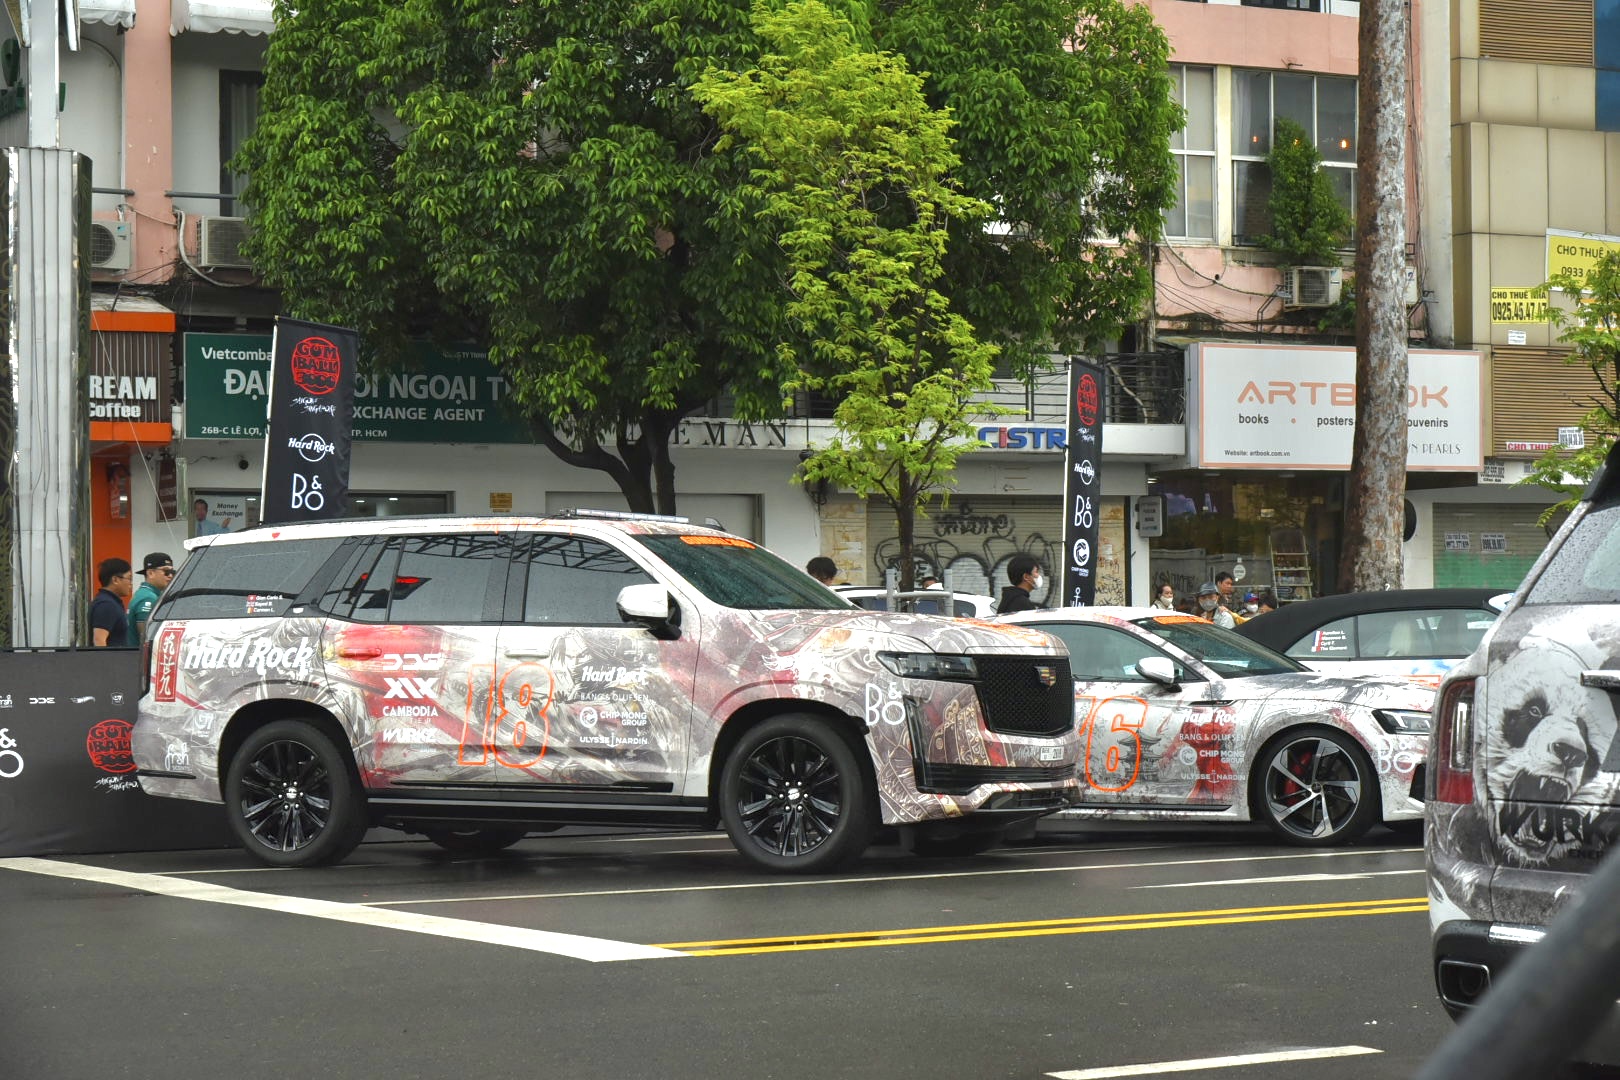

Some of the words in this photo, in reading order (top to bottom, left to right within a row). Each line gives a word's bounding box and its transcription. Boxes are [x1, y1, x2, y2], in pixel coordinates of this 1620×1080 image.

[1557, 245, 1577, 256] CHO
[1580, 247, 1603, 258] THUÊ
[1561, 266, 1584, 278] 0933
[1492, 291, 1507, 299] CHO
[389, 373, 476, 405] NGOẠI
[1237, 380, 1449, 409] ARTBK
[433, 408, 486, 422] AGENT
[1238, 413, 1270, 425] books
[1316, 416, 1354, 427] posters
[201, 426, 229, 435] 26B-C
[288, 437, 314, 450] Hard
[313, 440, 335, 455] Rock
[1422, 443, 1461, 455] PEARLS
[1507, 443, 1526, 451] CHO
[1224, 449, 1249, 457] Website:
[184, 636, 252, 670] Hard
[248, 637, 314, 676] Rock
[581, 665, 617, 682] Hard
[382, 705, 439, 717] CAMBODIA
[457, 662, 555, 769] 18
[600, 711, 620, 720] CHIP
[622, 712, 647, 720] MONG
[615, 737, 648, 745] NARDIN
[1180, 733, 1202, 741] BANG
[1200, 750, 1219, 758] CHIP
